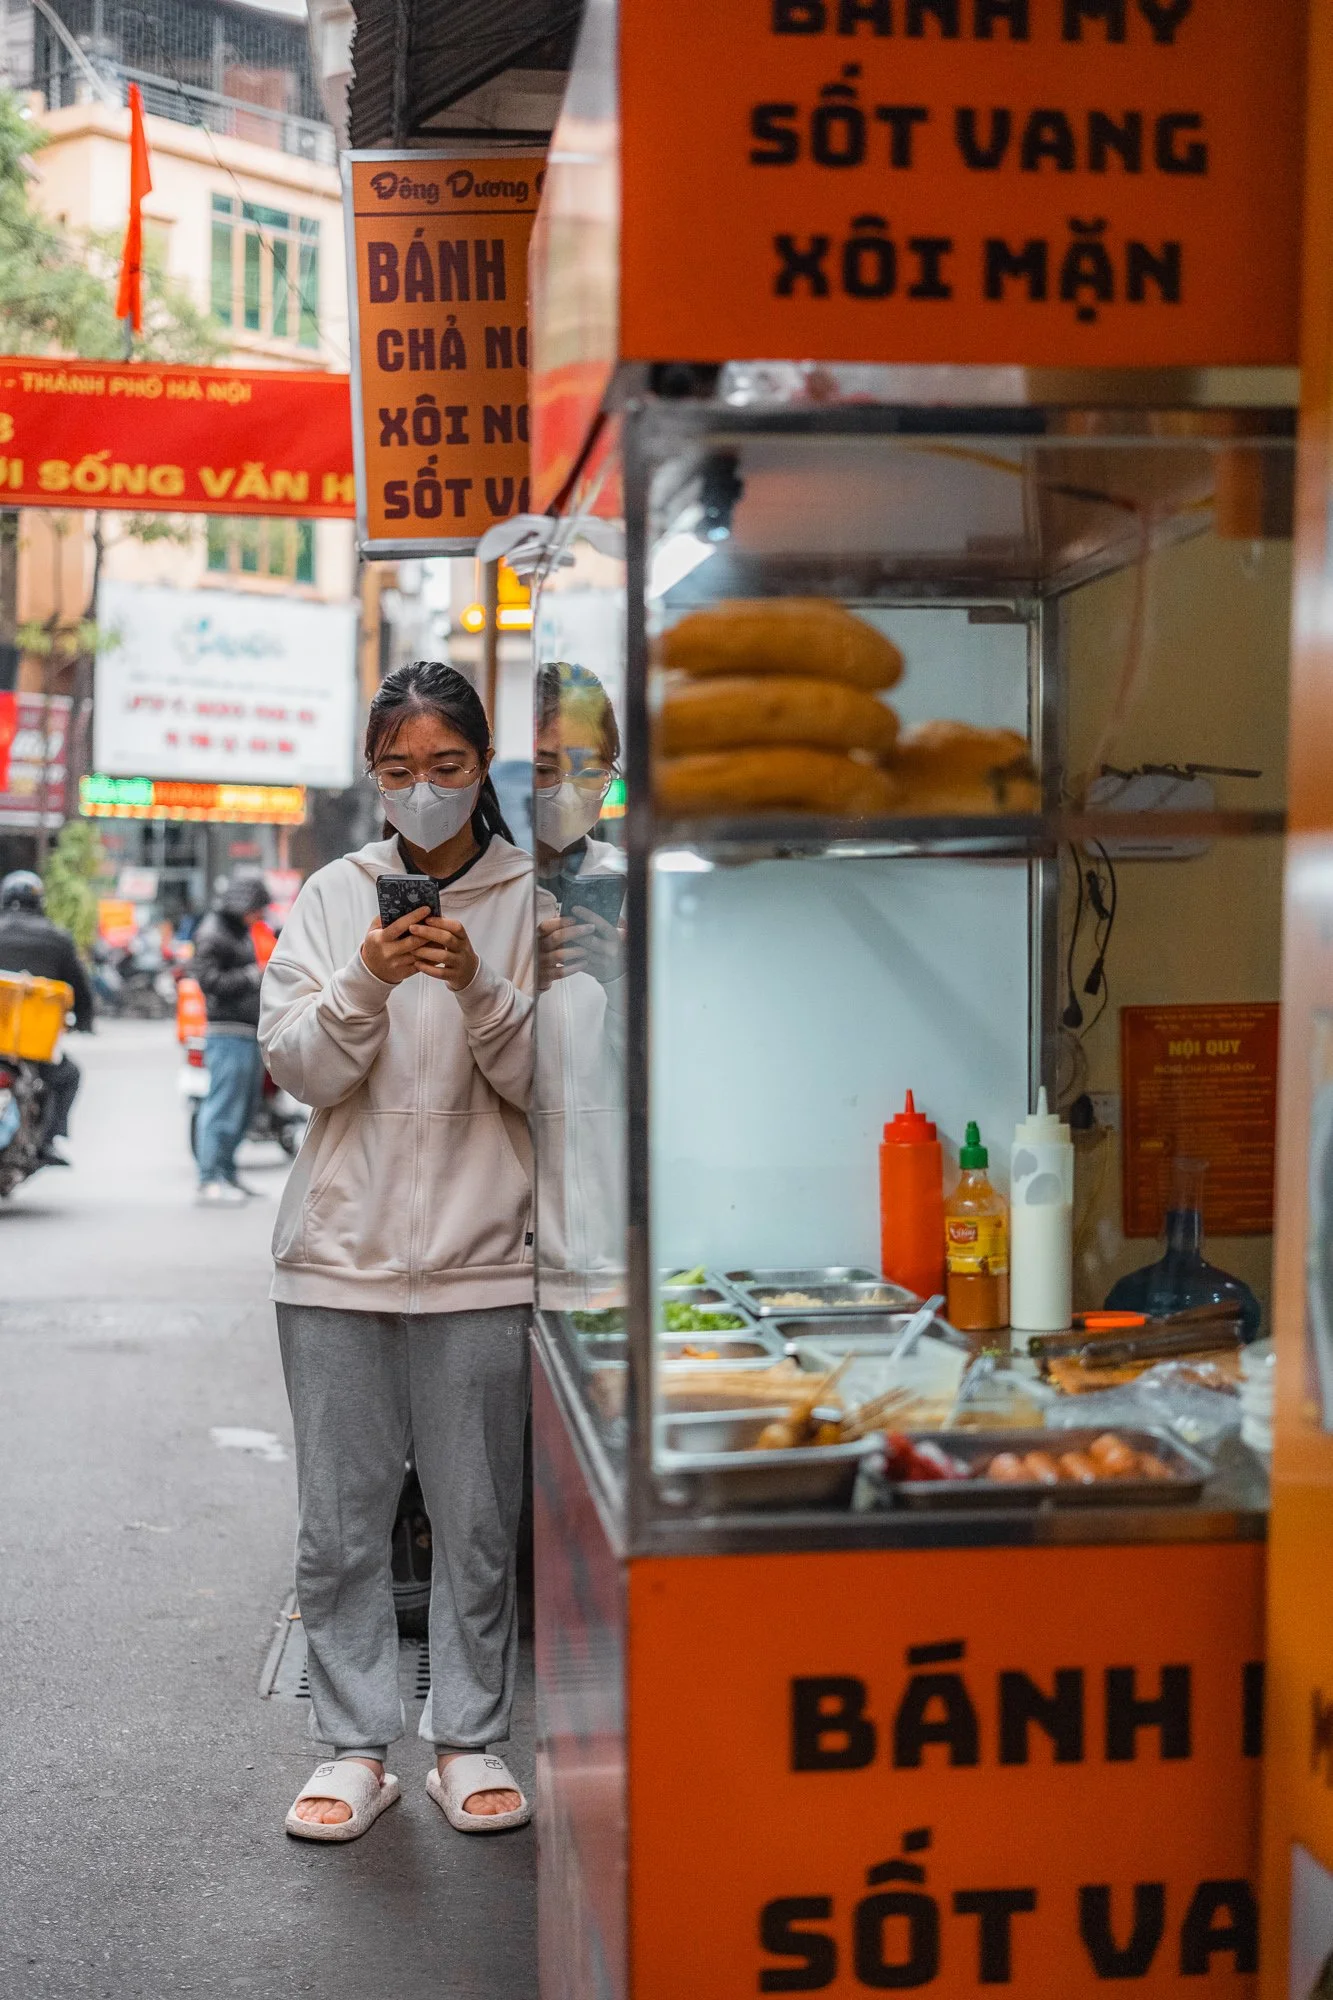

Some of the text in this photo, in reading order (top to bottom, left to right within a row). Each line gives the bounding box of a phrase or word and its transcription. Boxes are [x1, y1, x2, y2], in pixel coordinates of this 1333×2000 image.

[749, 62, 1208, 176] SỐT VANG
[370, 171, 440, 205] Đông
[446, 169, 529, 204] Dương
[367, 227, 506, 303] BÁNH
[773, 213, 1182, 324] XÔI MẶN
[376, 314, 467, 373] CHẢ
[378, 393, 469, 447] XÔI
[38, 449, 186, 496] SỐNG
[199, 460, 310, 502] VĂN
[383, 454, 473, 519] SỐT
[790, 1638, 1193, 1773] BÁNH
[758, 1826, 1037, 1994] SỐT
